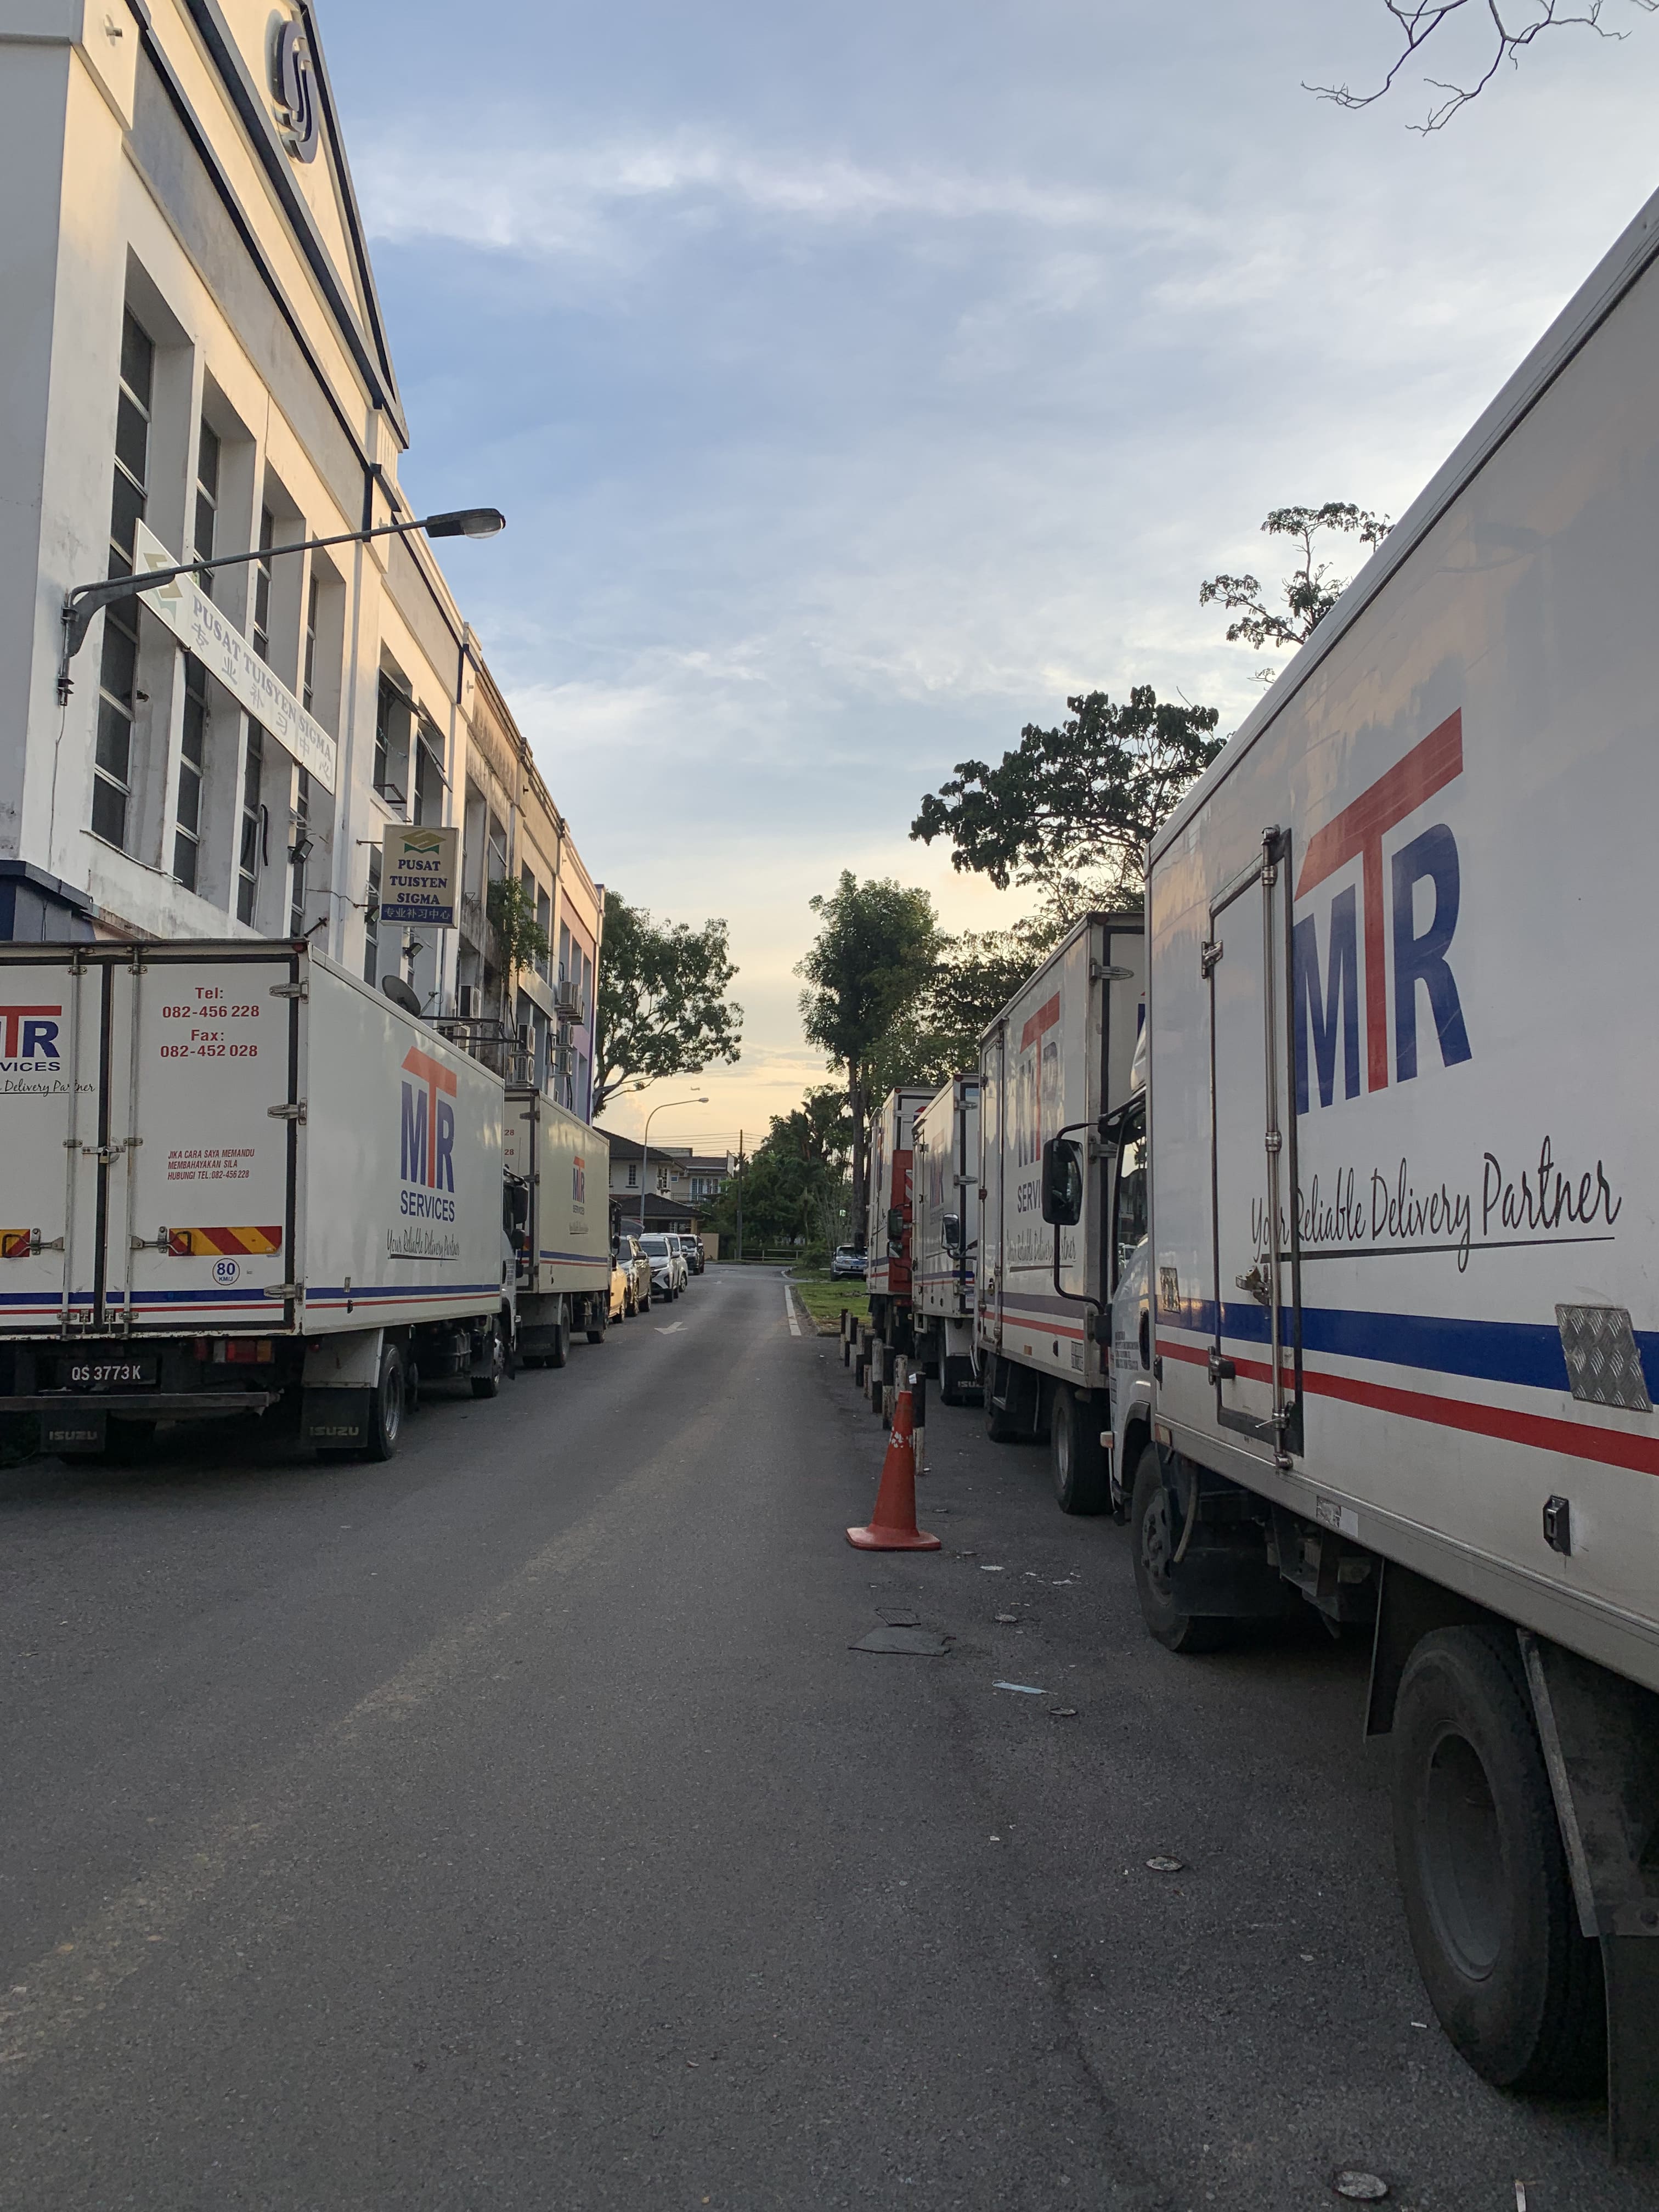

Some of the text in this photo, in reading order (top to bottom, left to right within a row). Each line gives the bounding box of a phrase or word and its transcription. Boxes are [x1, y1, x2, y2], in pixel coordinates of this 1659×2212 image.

[193, 594, 332, 761] PUSAT TUISYEN SIGMA
[191, 622, 331, 782] 专业补习中心
[398, 859, 441, 871] PUSAT
[390, 876, 448, 889] TUISYEN
[397, 893, 440, 905] SIGMA
[385, 907, 450, 919] 专业补习中心
[1293, 706, 1472, 1116] MTR
[195, 988, 223, 999] Tel:
[162, 1005, 259, 1018] 082-456 228
[0, 1005, 62, 1058] TR
[191, 1029, 224, 1041] Fax:
[160, 1045, 258, 1057] 082-452 028
[5, 1079, 95, 1097] Delivery Patner
[400, 1046, 457, 1193] MTR
[204, 1150, 219, 1158] SAYA
[222, 1149, 255, 1157] MEMANDU
[168, 1160, 238, 1169] MEMBAHAYAKAN SILA
[167, 1171, 195, 1180] HUBUNGI
[1018, 1180, 1042, 1213] SERVI
[400, 1190, 455, 1222] SERVICES
[1251, 1197, 1289, 1263] Yor
[1371, 1157, 1470, 1273] Delivery
[1483, 1135, 1622, 1235] Partner
[217, 1262, 235, 1275] 80
[49, 1431, 97, 1440] ISUZU
[309, 1426, 359, 1436] ISUZU
